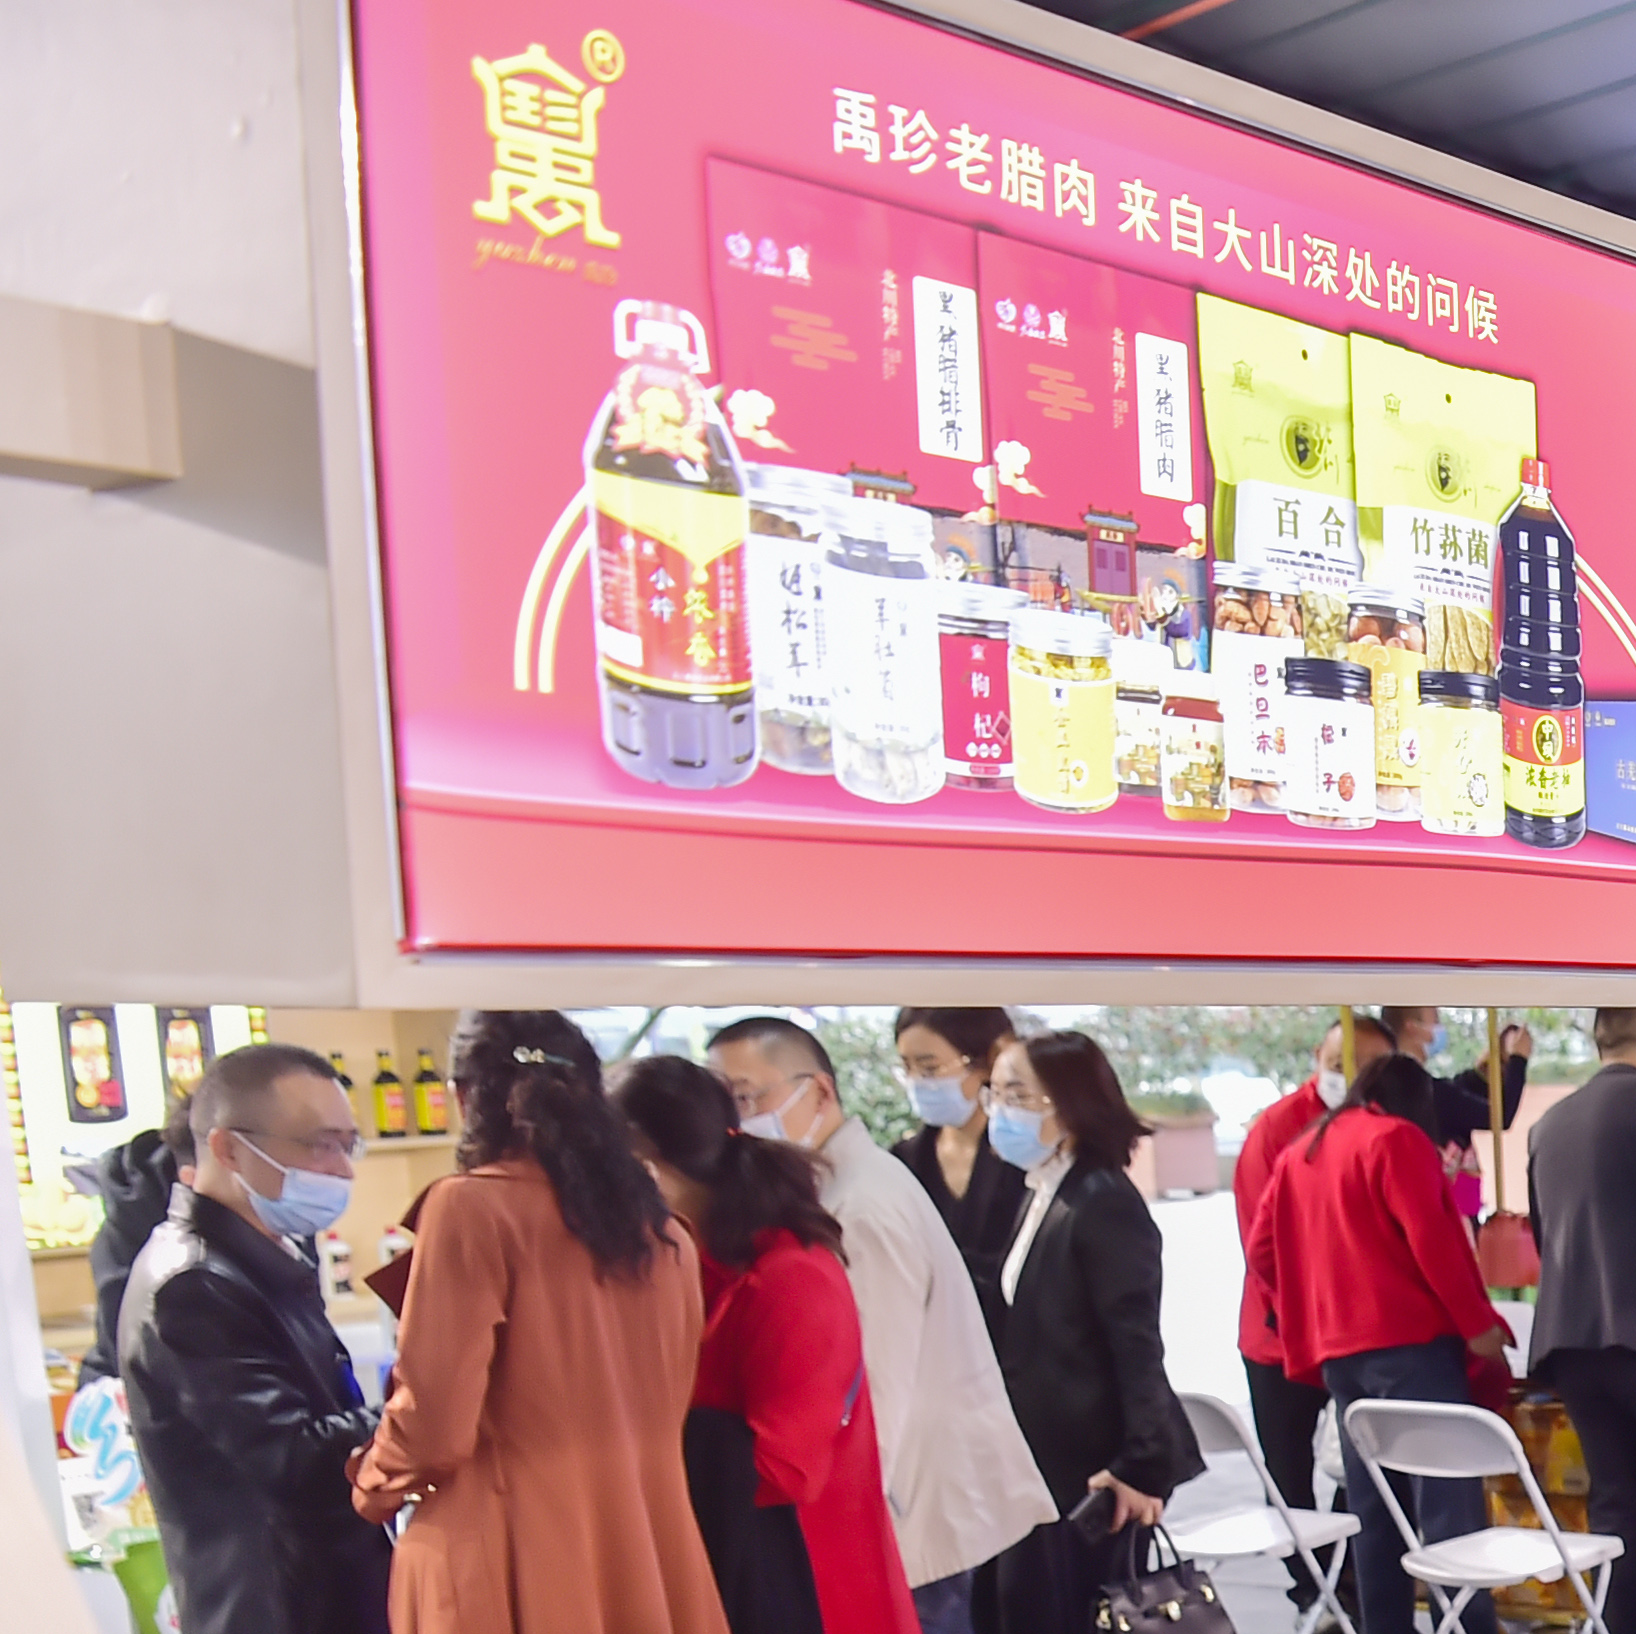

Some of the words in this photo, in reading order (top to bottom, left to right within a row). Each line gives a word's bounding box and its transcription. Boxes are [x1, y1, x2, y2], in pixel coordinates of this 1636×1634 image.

[832, 86, 1098, 227] 禹珍老腊肉
[1116, 177, 1500, 346] 来自大山深处的问候
[1272, 496, 1346, 549] 百合
